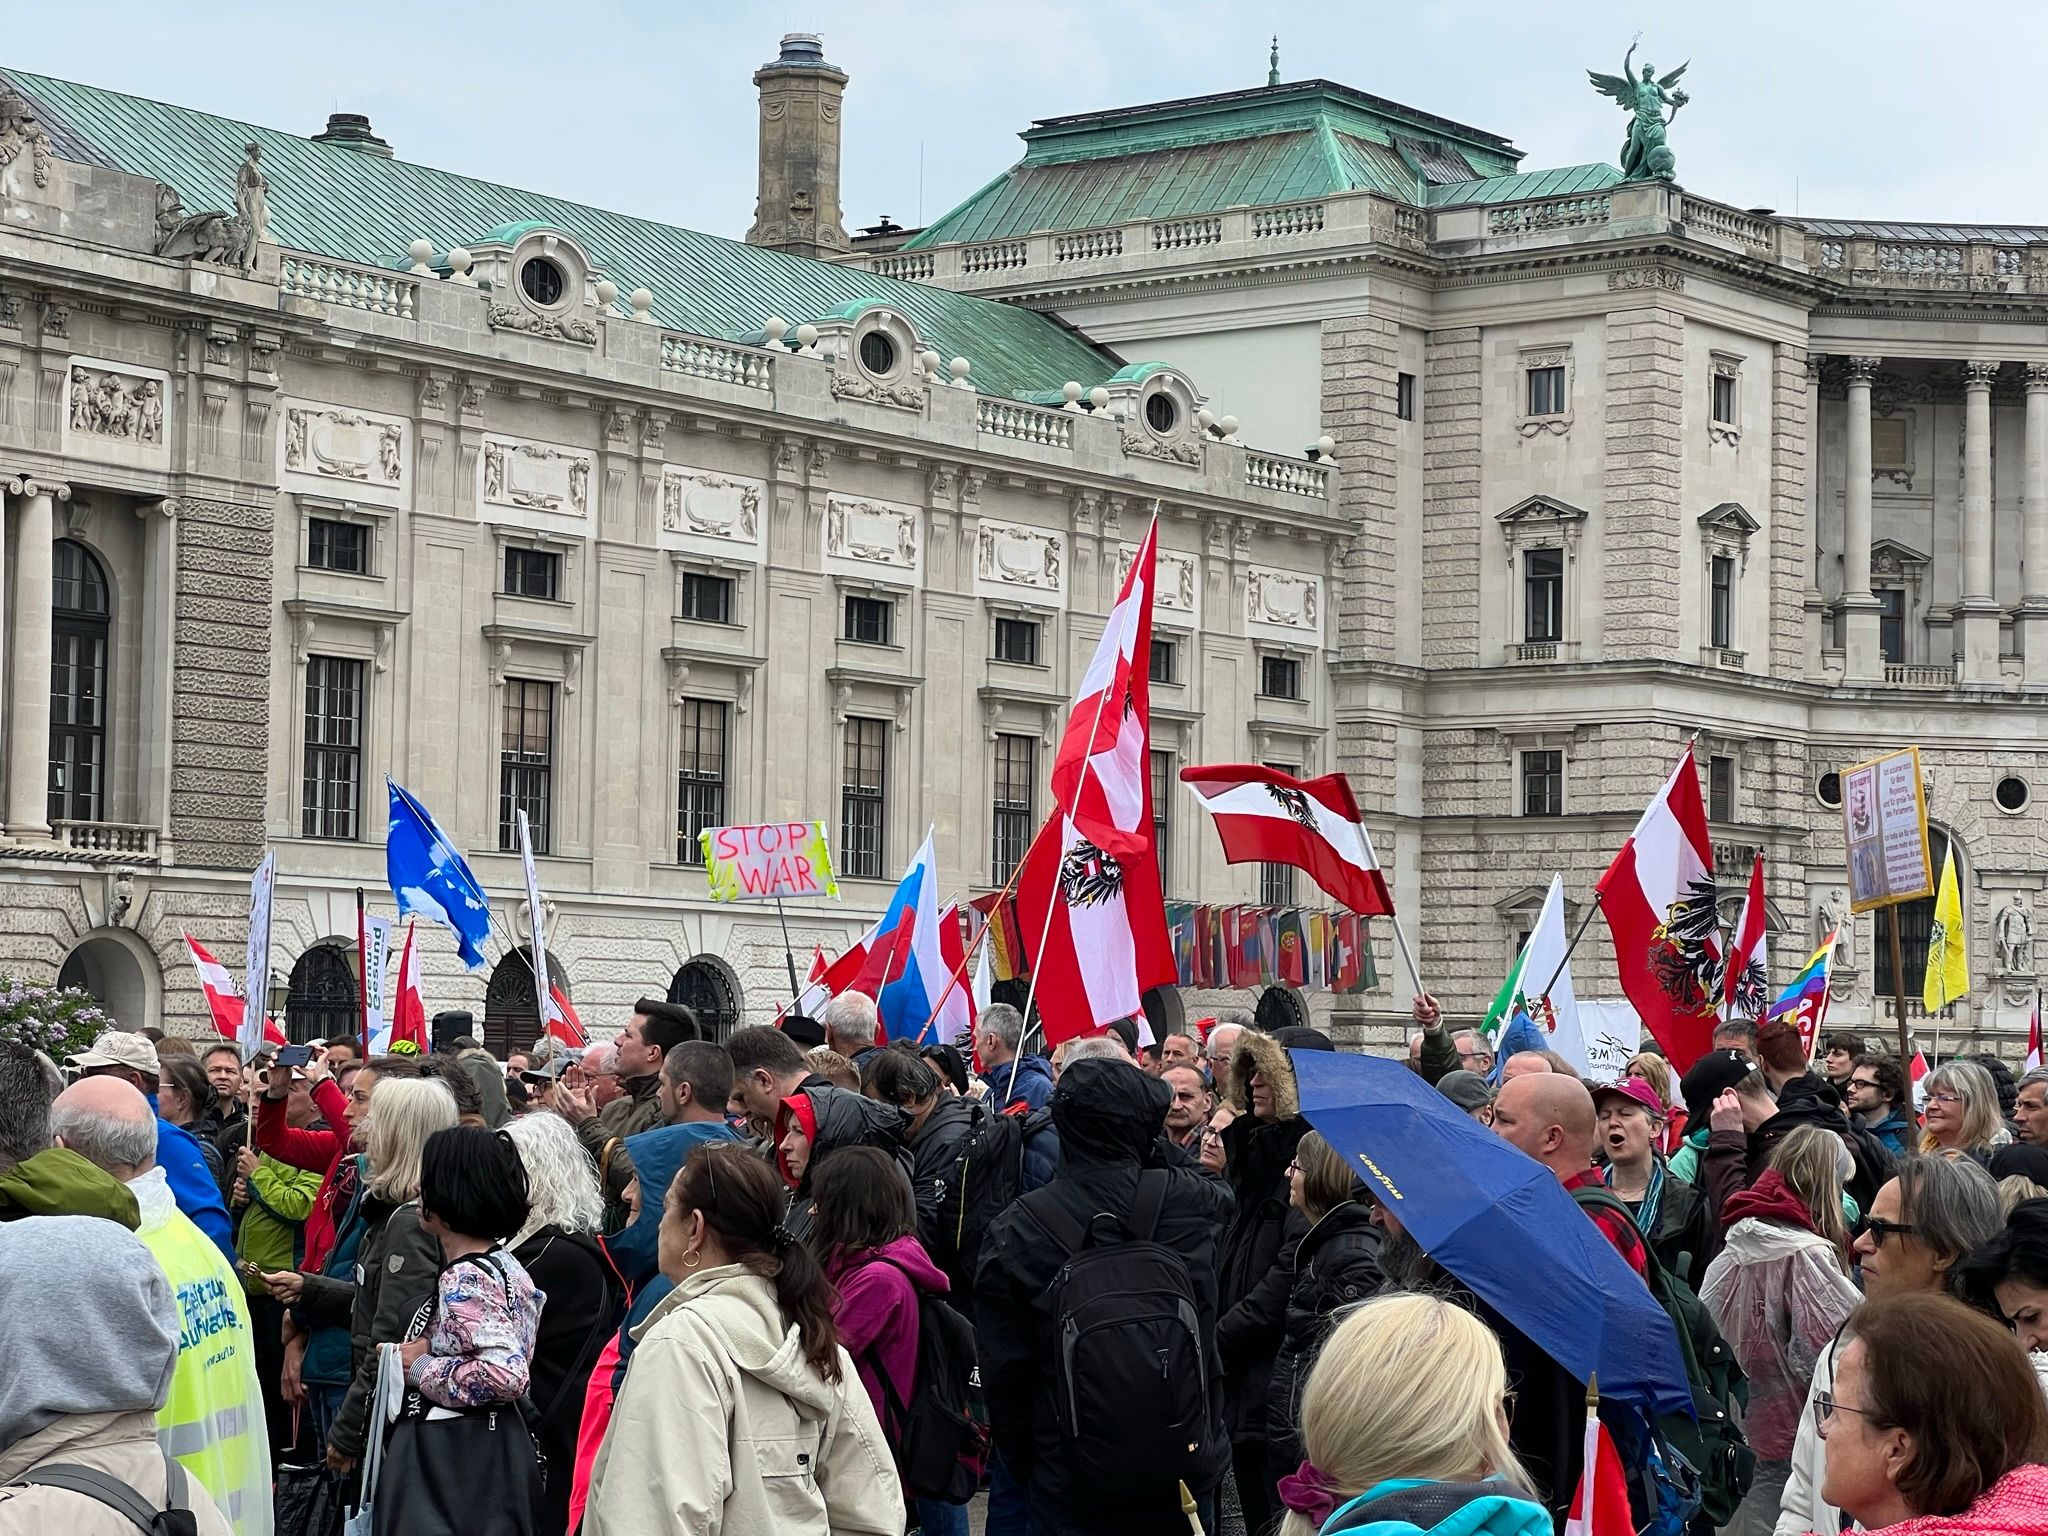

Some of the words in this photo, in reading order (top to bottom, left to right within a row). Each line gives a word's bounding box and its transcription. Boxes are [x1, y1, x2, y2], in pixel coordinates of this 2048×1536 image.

[718, 823, 807, 860] STOP
[737, 856, 817, 895] WAR
[373, 926, 382, 1011] Gesund
[1359, 1153, 1404, 1200] GOODYEAR
[177, 1283, 207, 1316] Zeit
